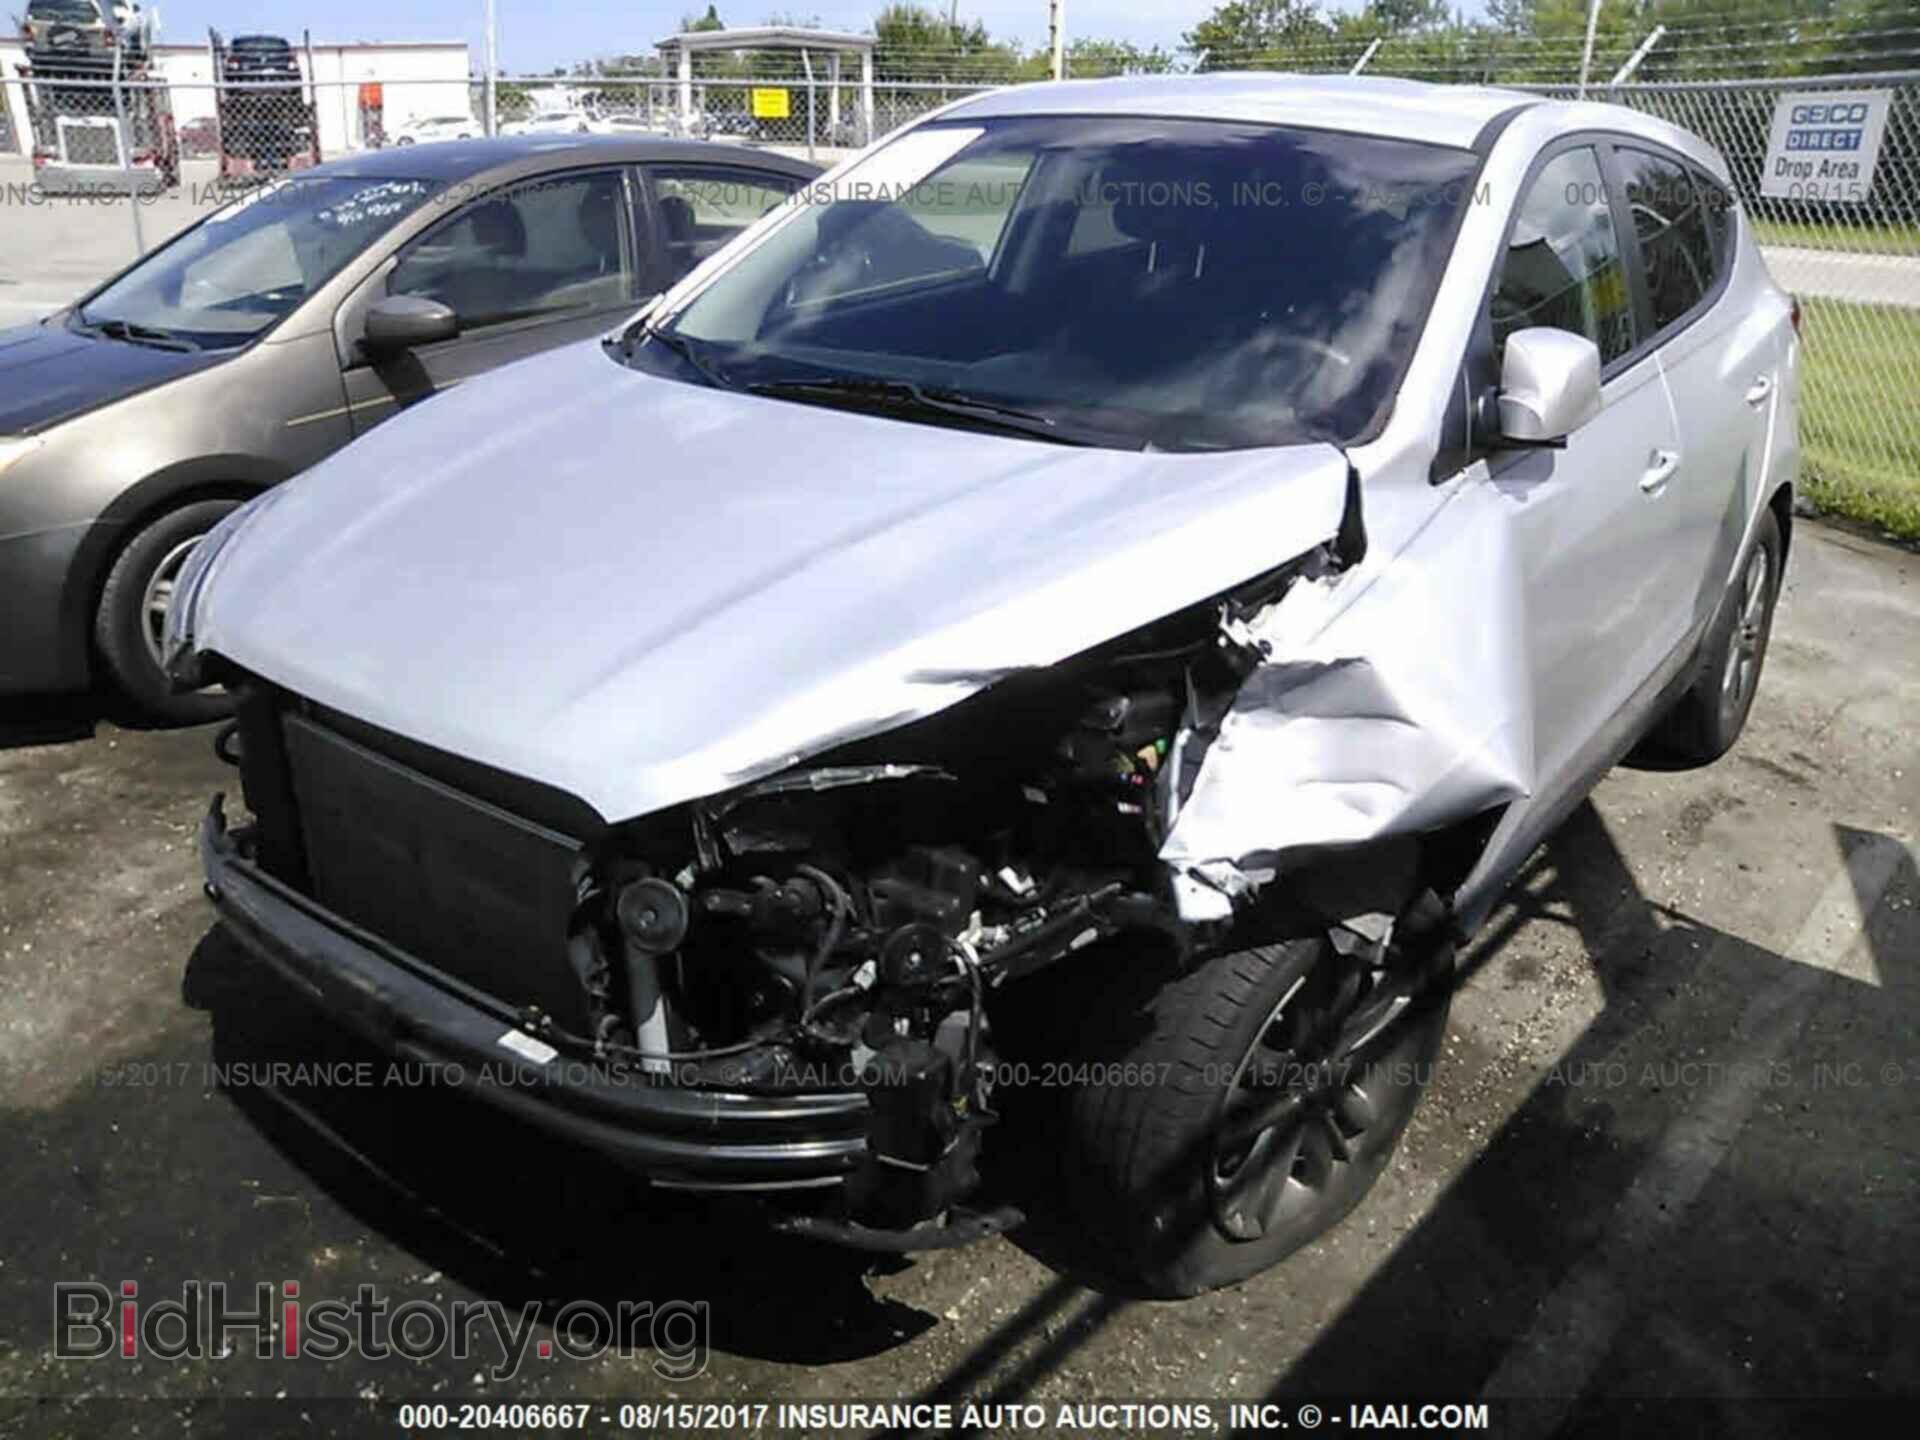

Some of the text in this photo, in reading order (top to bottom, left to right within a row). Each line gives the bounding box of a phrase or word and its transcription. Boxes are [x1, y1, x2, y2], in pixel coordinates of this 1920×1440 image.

[1791, 103, 1869, 124] GEICO
[1788, 130, 1860, 149] DIRECT
[1775, 157, 1860, 181] Drop Area
